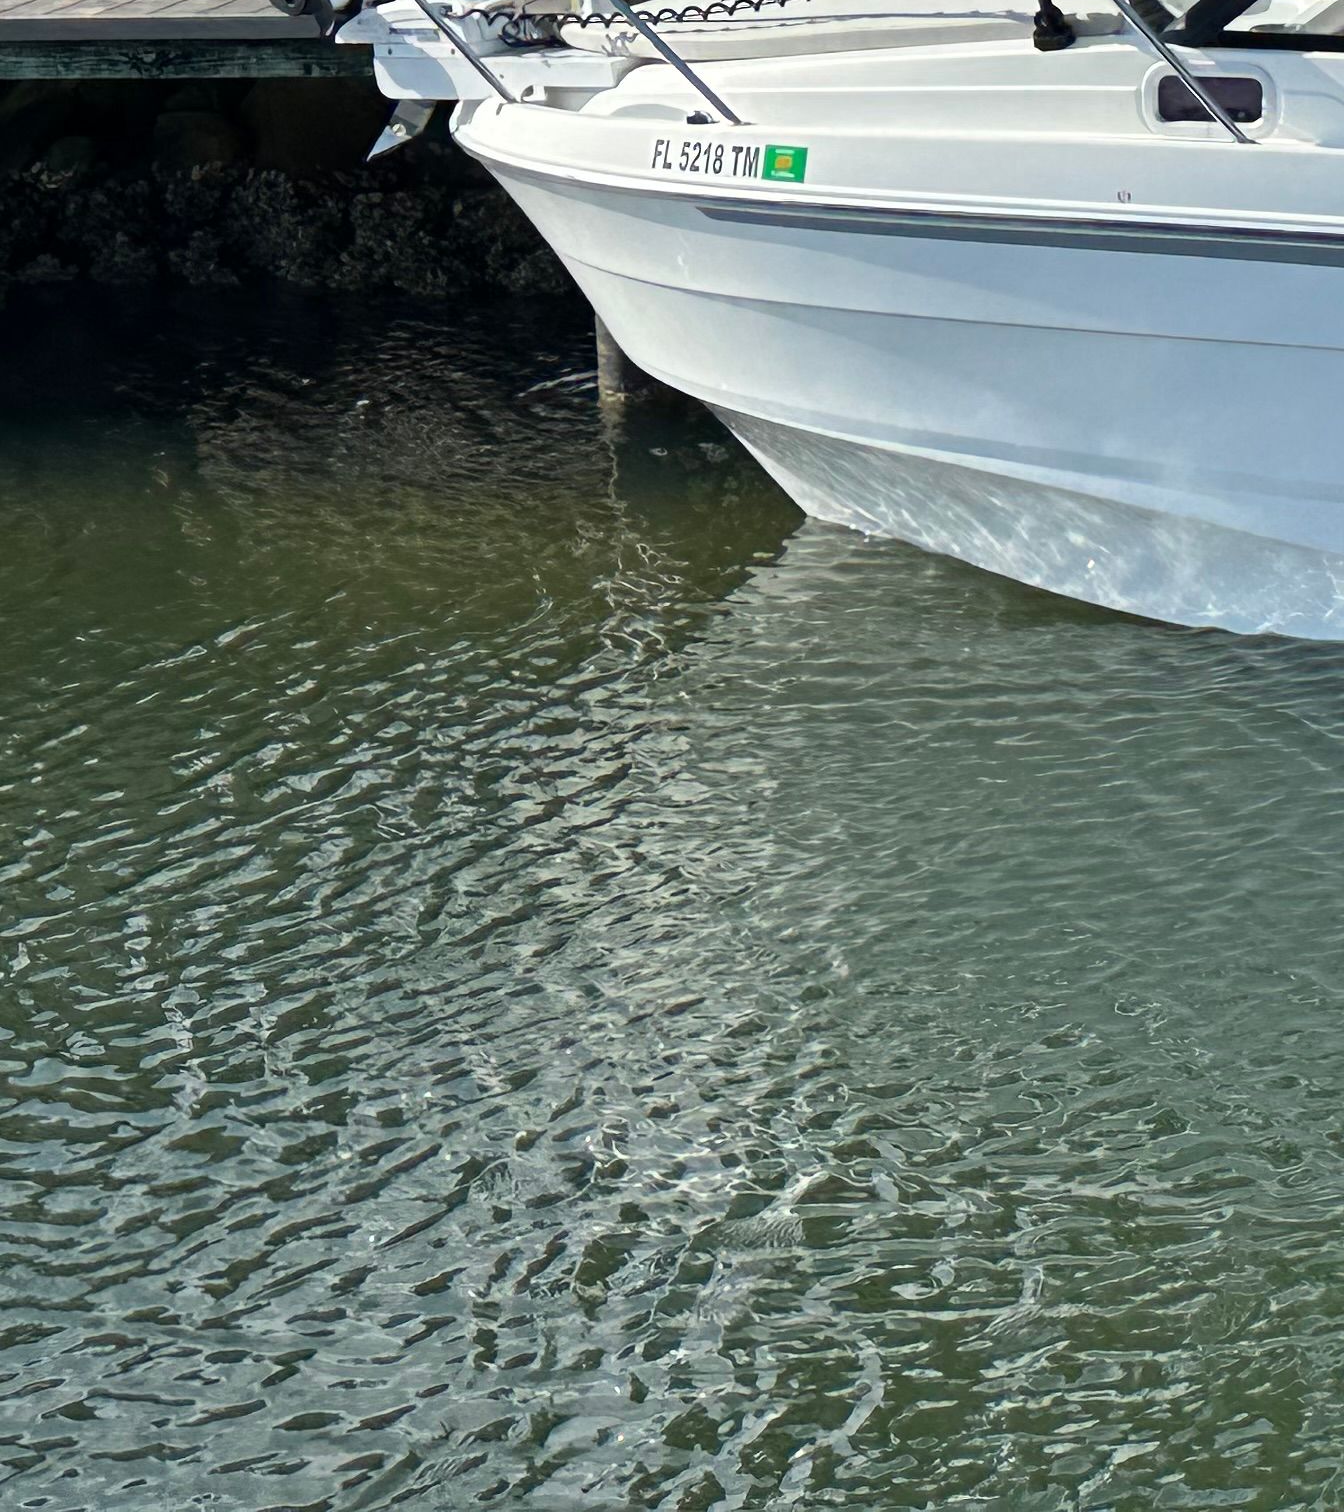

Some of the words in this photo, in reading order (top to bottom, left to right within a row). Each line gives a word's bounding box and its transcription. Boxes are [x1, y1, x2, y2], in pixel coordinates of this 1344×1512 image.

[652, 139, 672, 169] FL
[679, 141, 724, 175] 5218
[732, 146, 760, 178] TM
